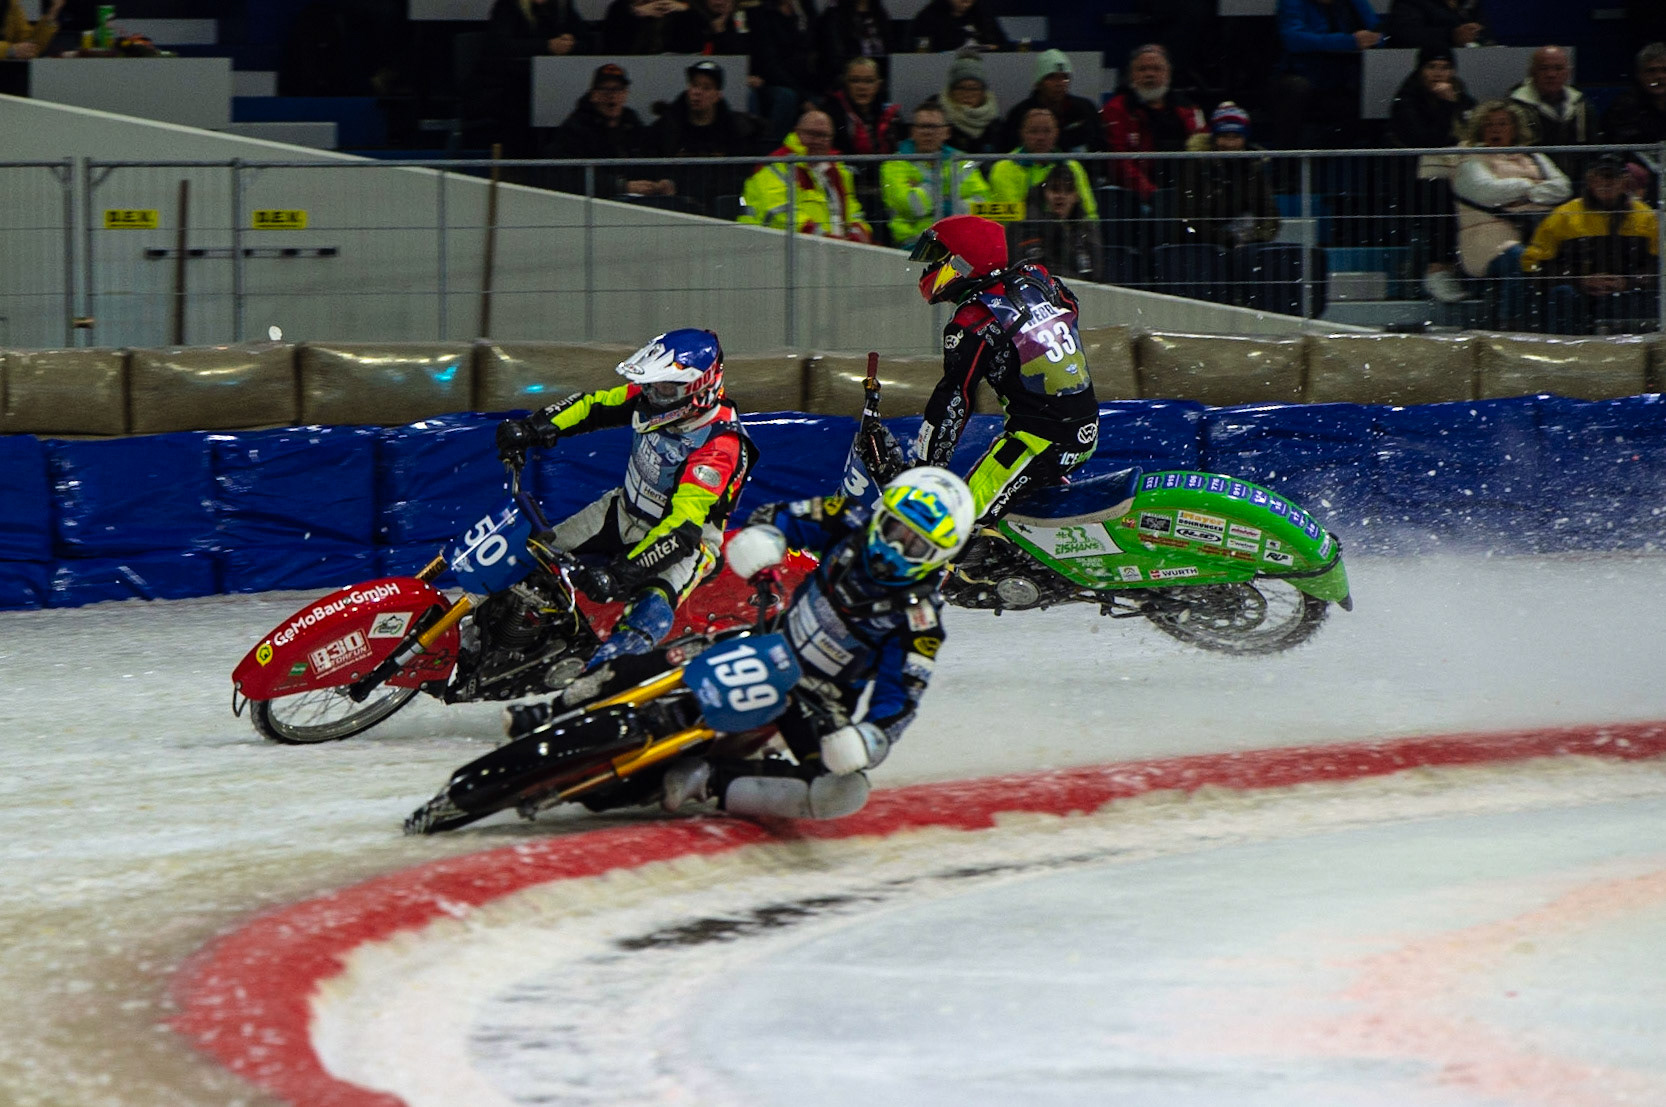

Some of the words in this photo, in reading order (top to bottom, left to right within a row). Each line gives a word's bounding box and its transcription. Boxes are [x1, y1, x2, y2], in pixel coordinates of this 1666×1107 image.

[1036, 321, 1077, 363] 33
[464, 515, 508, 566] 50
[705, 644, 779, 713] 199
